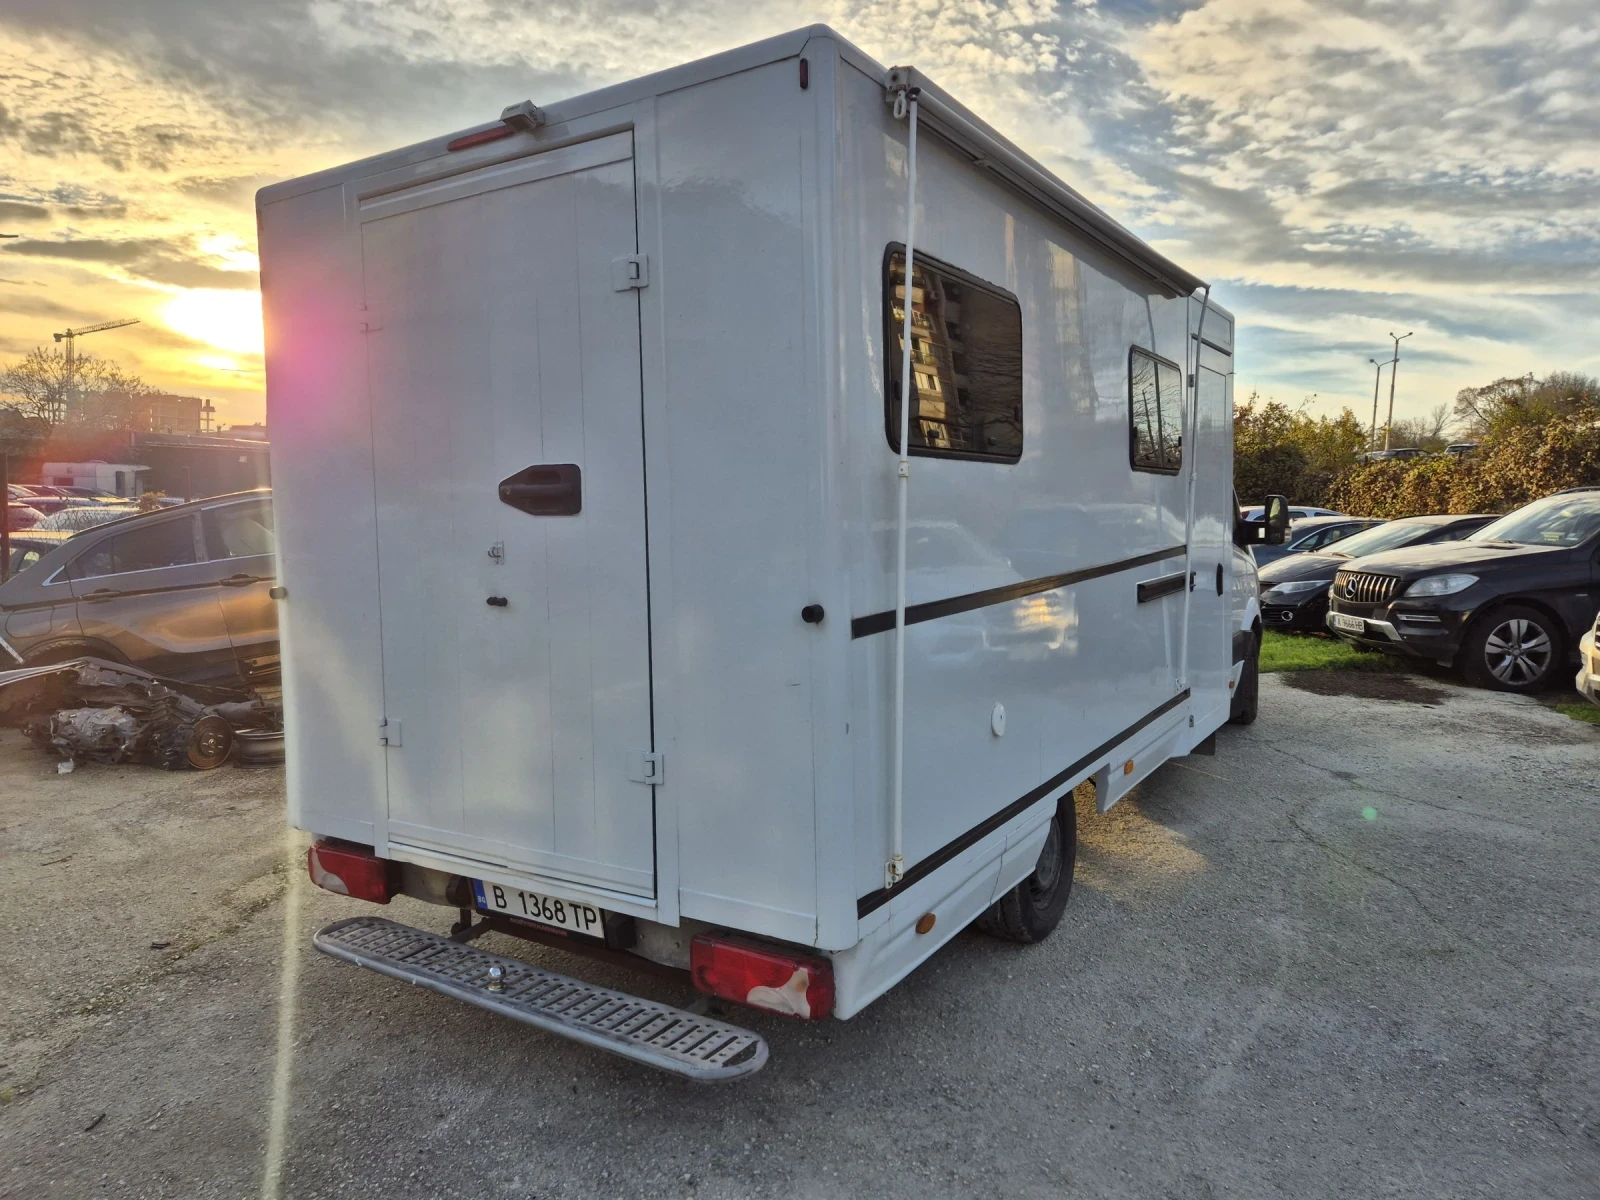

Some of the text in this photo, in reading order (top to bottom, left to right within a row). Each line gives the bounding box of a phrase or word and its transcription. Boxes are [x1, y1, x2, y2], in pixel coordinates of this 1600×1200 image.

[478, 895, 486, 903] BG
[492, 885, 507, 909] B
[518, 891, 566, 923] 1368
[569, 902, 597, 930] TP
